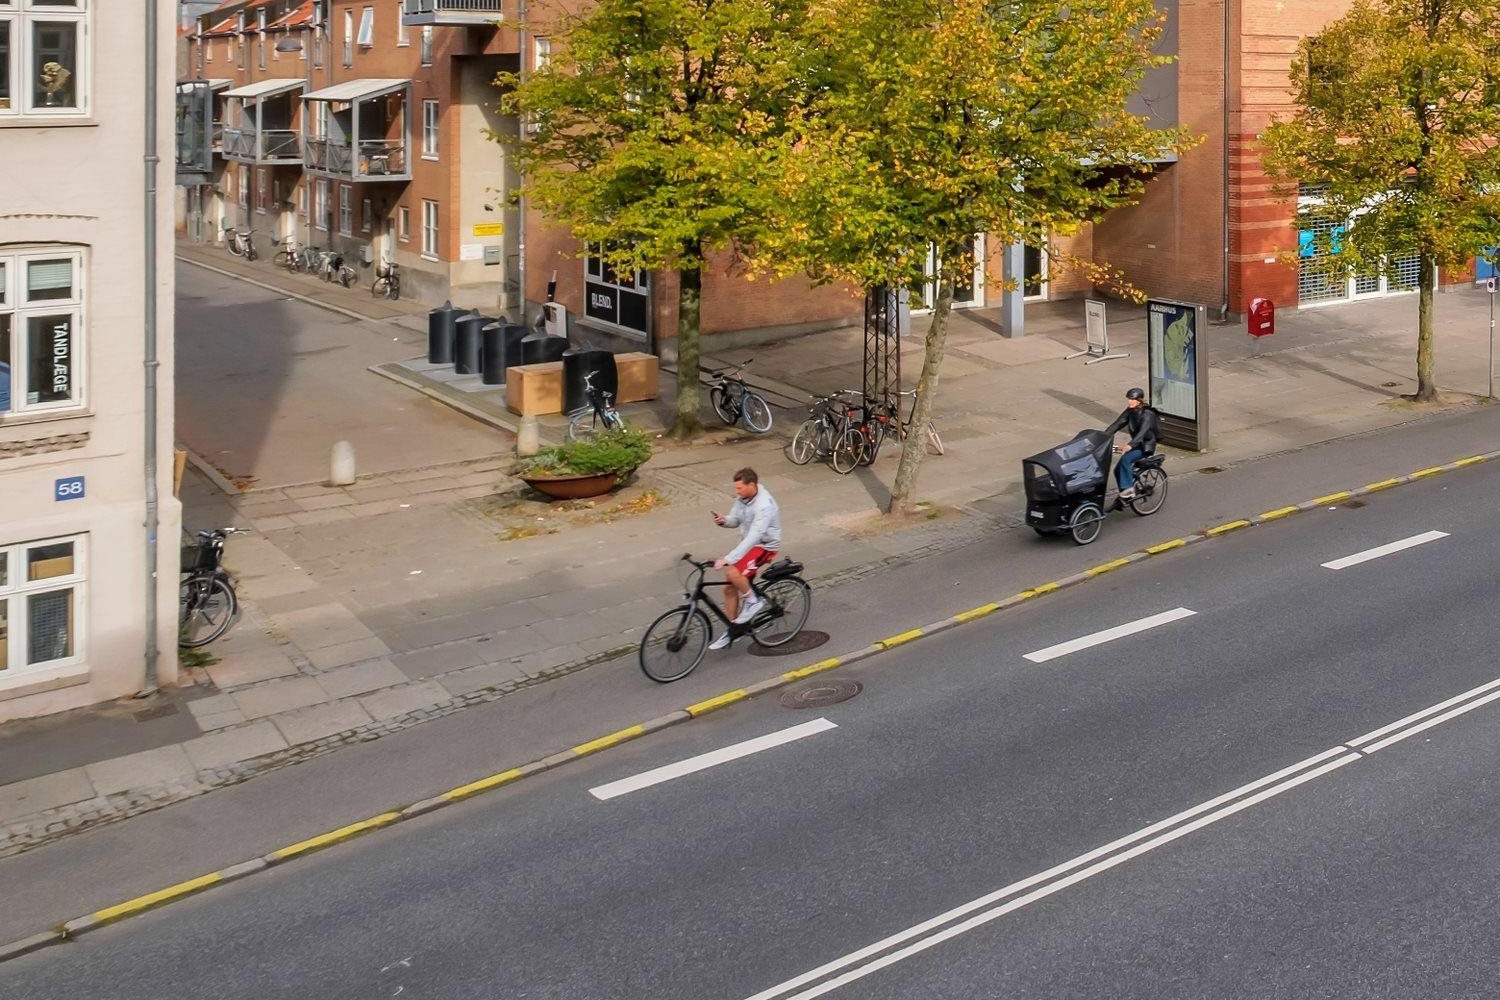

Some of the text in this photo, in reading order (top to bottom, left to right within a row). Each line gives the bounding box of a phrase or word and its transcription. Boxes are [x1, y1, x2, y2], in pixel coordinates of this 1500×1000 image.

[1150, 303, 1177, 315] AARHUS
[53, 322, 69, 393] TANDLÆGE
[58, 481, 82, 496] 58
